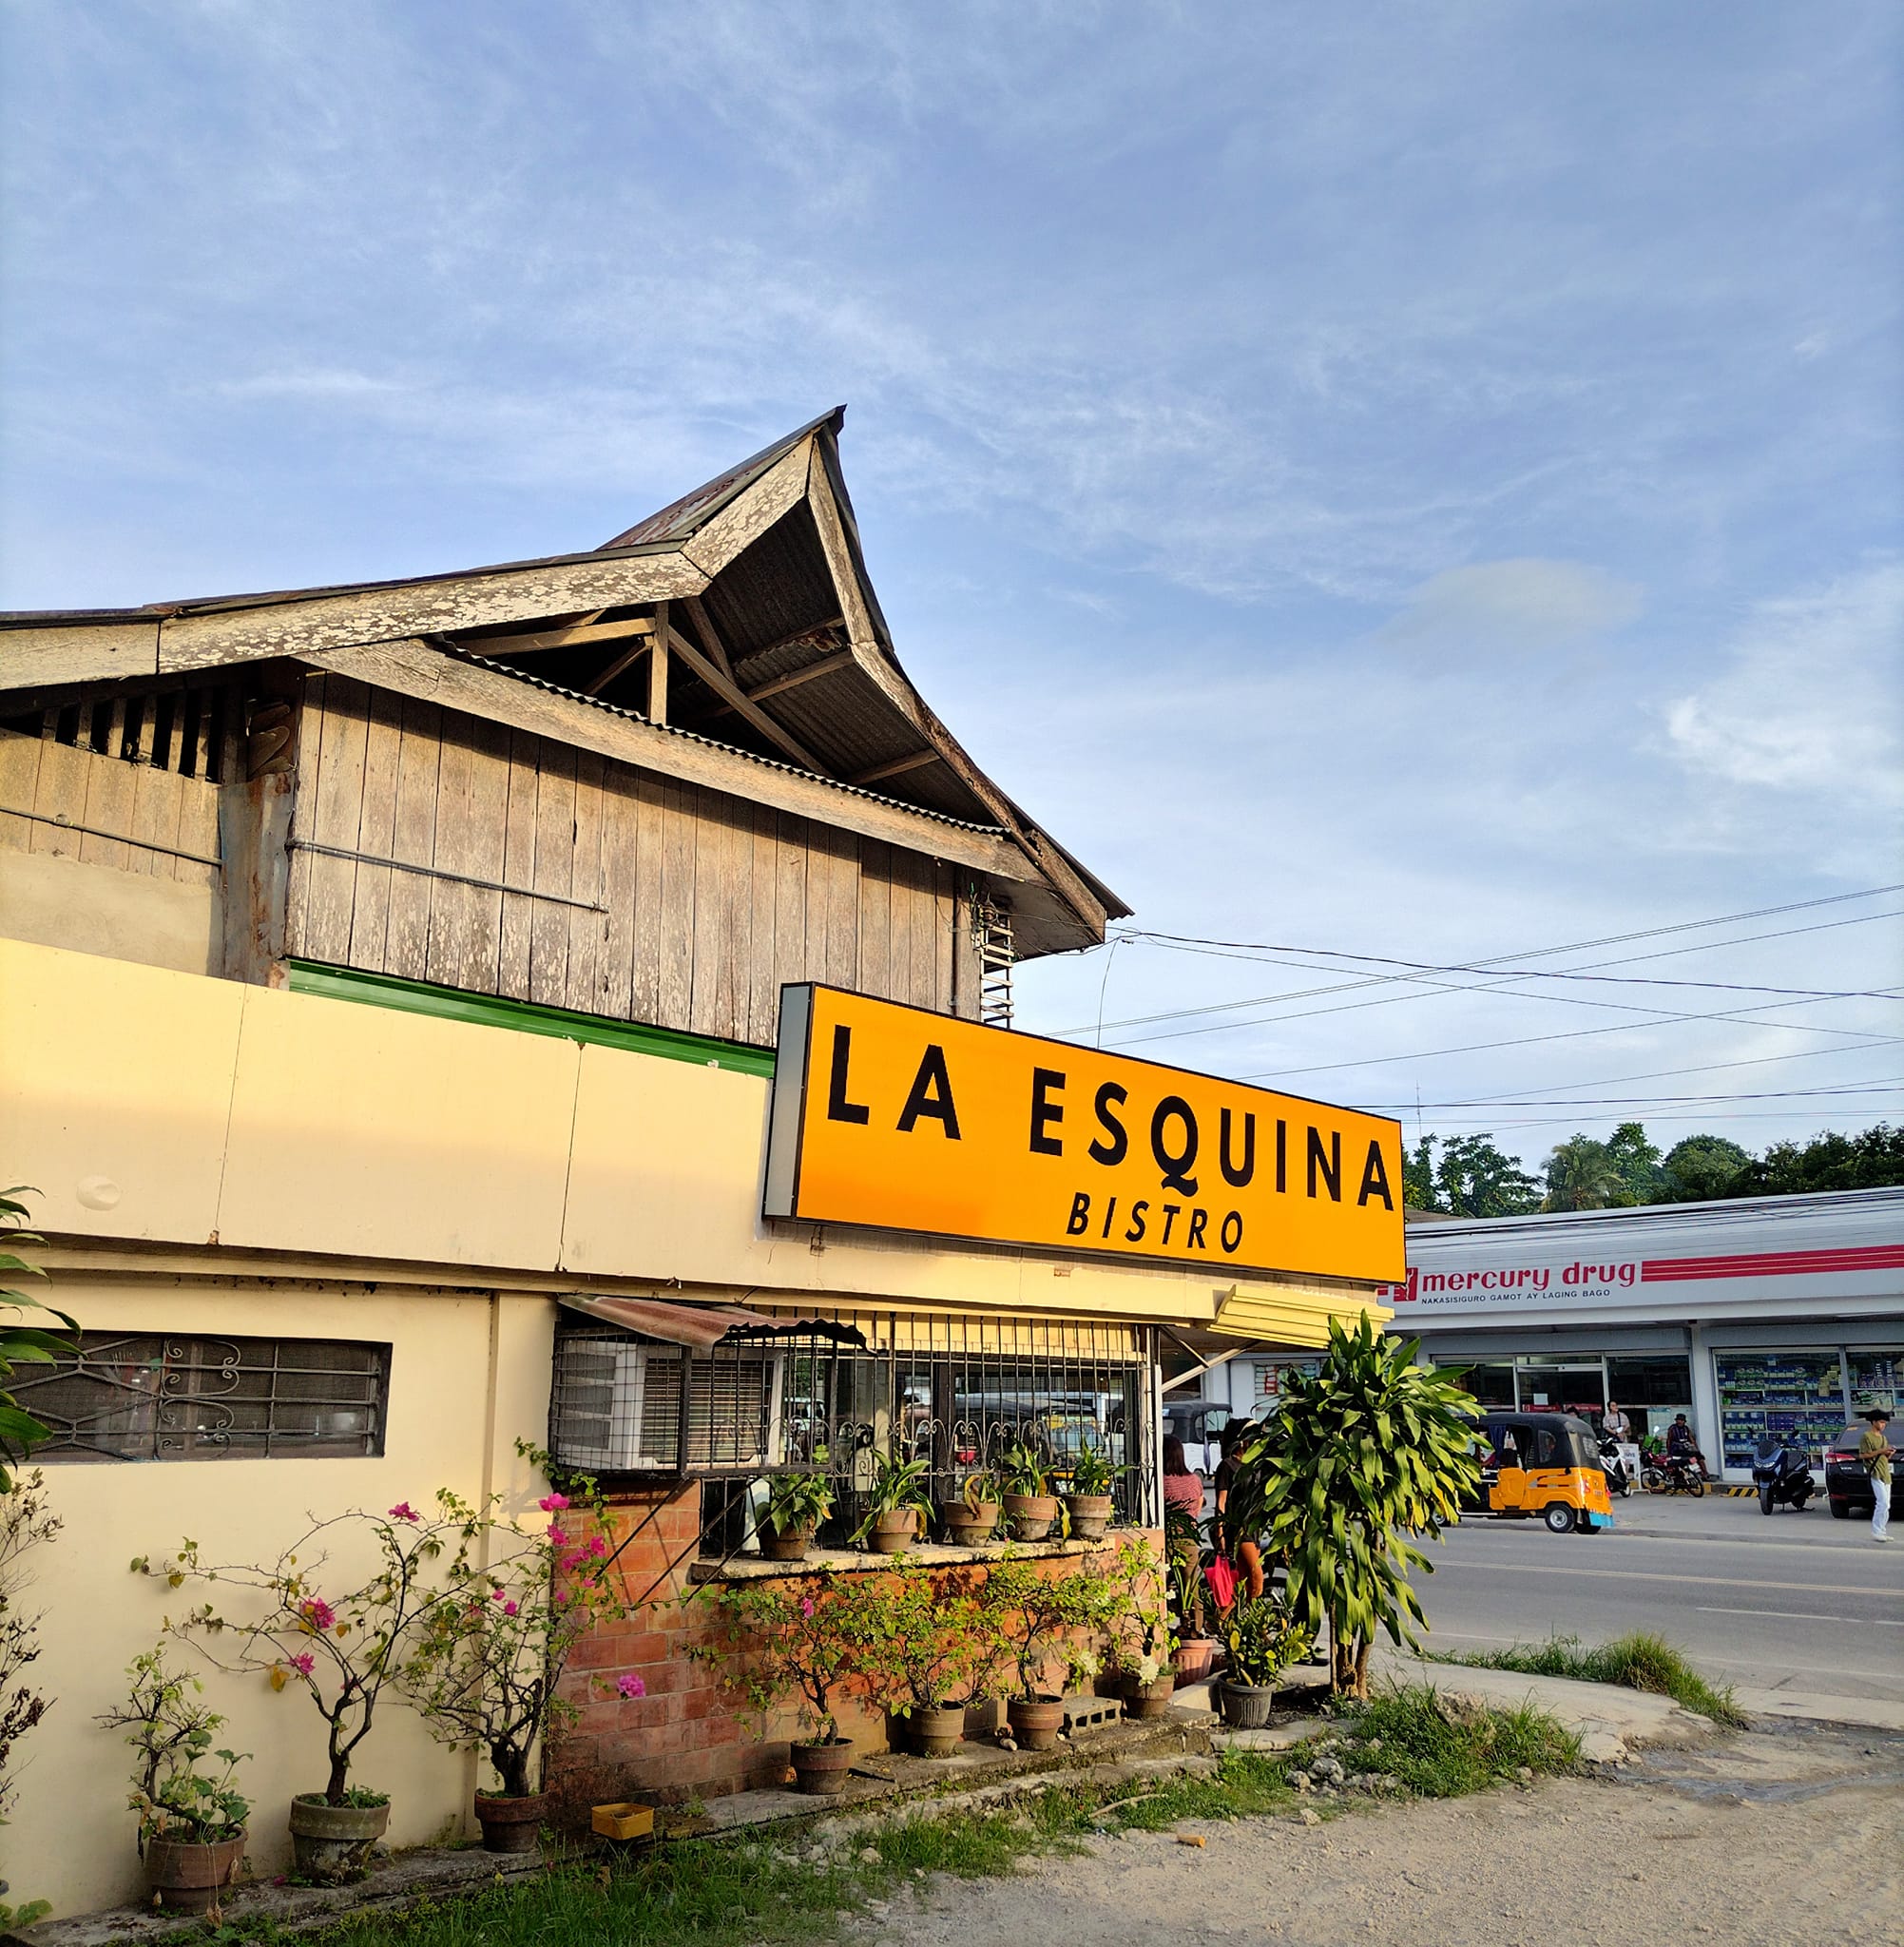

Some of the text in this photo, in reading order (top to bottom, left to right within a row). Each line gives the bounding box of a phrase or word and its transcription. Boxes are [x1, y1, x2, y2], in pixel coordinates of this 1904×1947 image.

[827, 1024, 1394, 1212] LA ESQUINA
[1066, 1191, 1243, 1254] BISTRO
[1421, 1294, 1486, 1304] NAKASISIGURO
[1490, 1293, 1522, 1301] GAMOT
[1543, 1290, 1578, 1300] LAGING
[1582, 1288, 1610, 1298] BAGO
[1422, 1262, 1636, 1292] mercury drug
